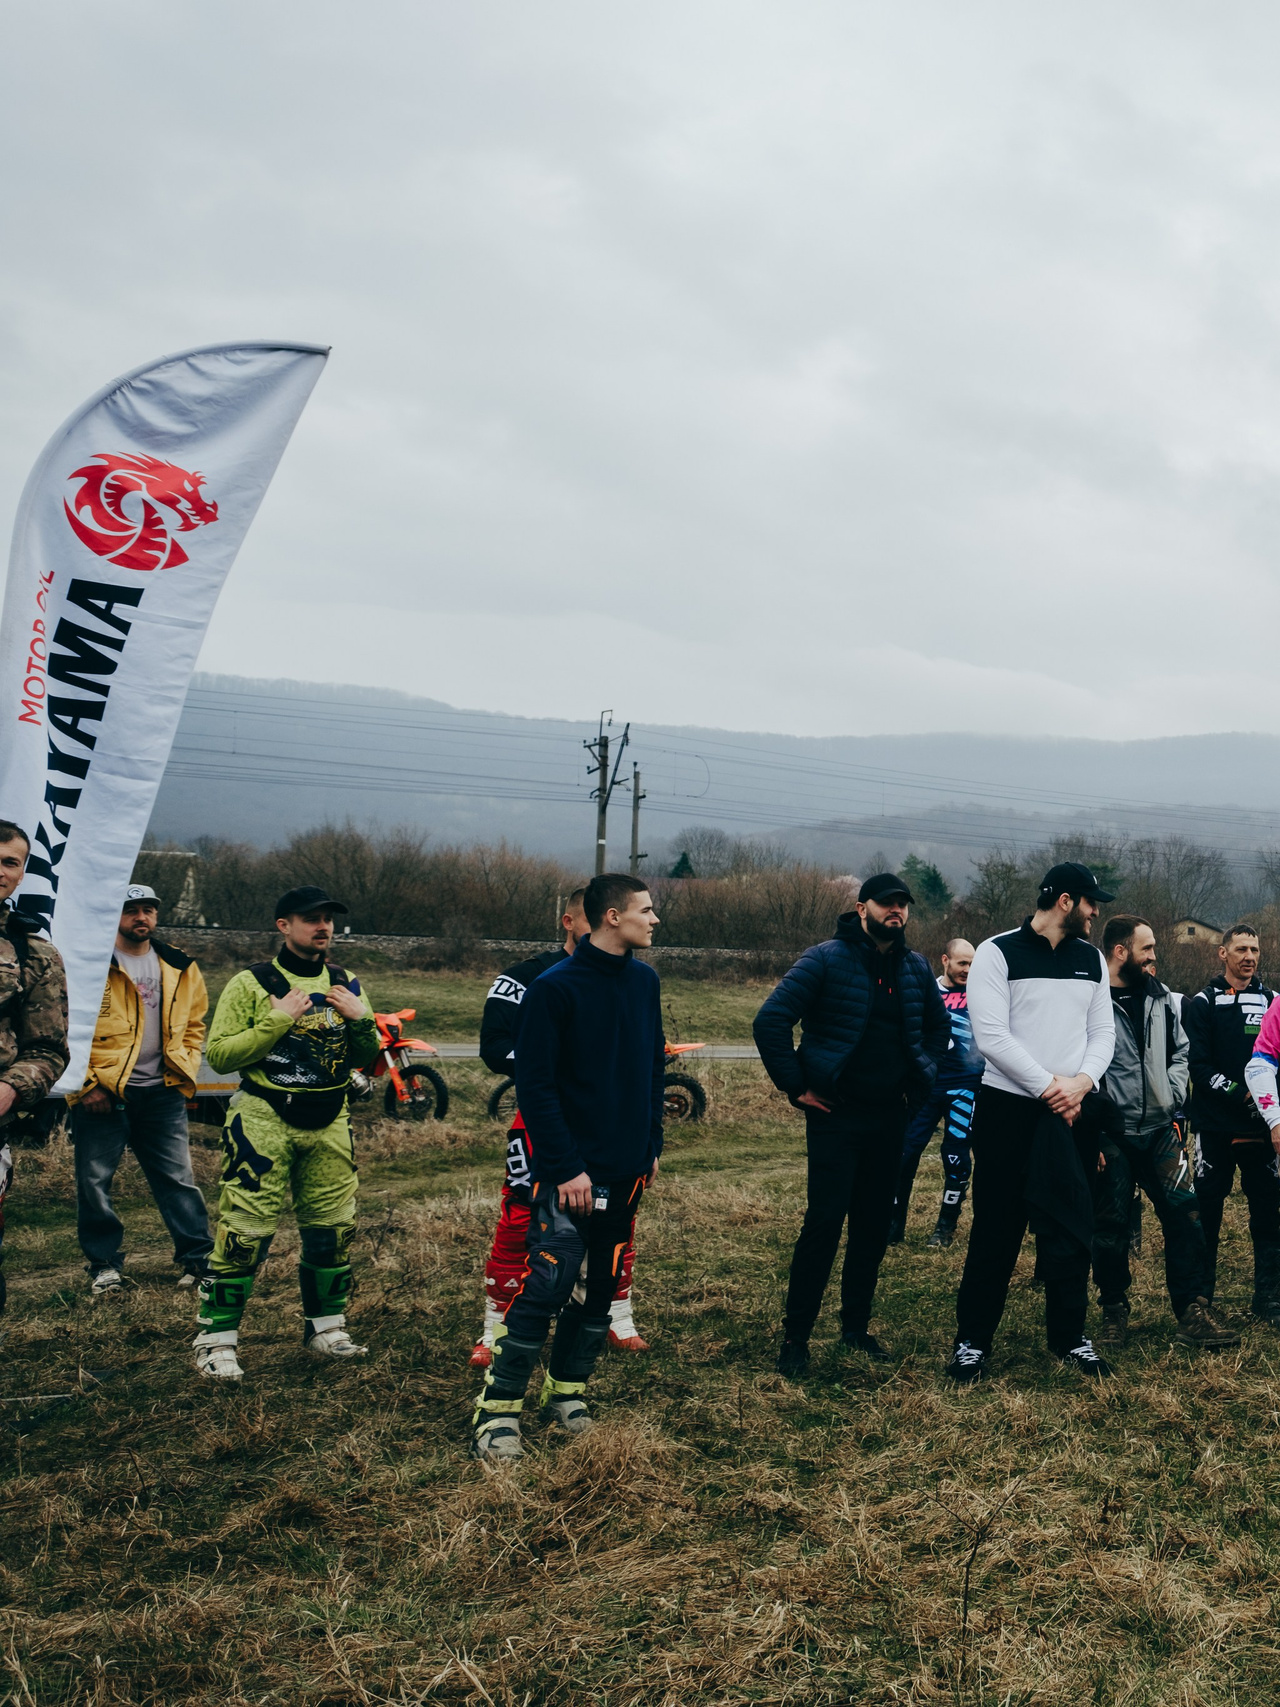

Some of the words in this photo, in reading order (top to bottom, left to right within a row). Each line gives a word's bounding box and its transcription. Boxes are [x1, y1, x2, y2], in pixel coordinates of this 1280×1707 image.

[16, 578, 145, 942] AKAYAMA
[507, 1137, 532, 1188] FOX
[215, 1282, 245, 1308] G
